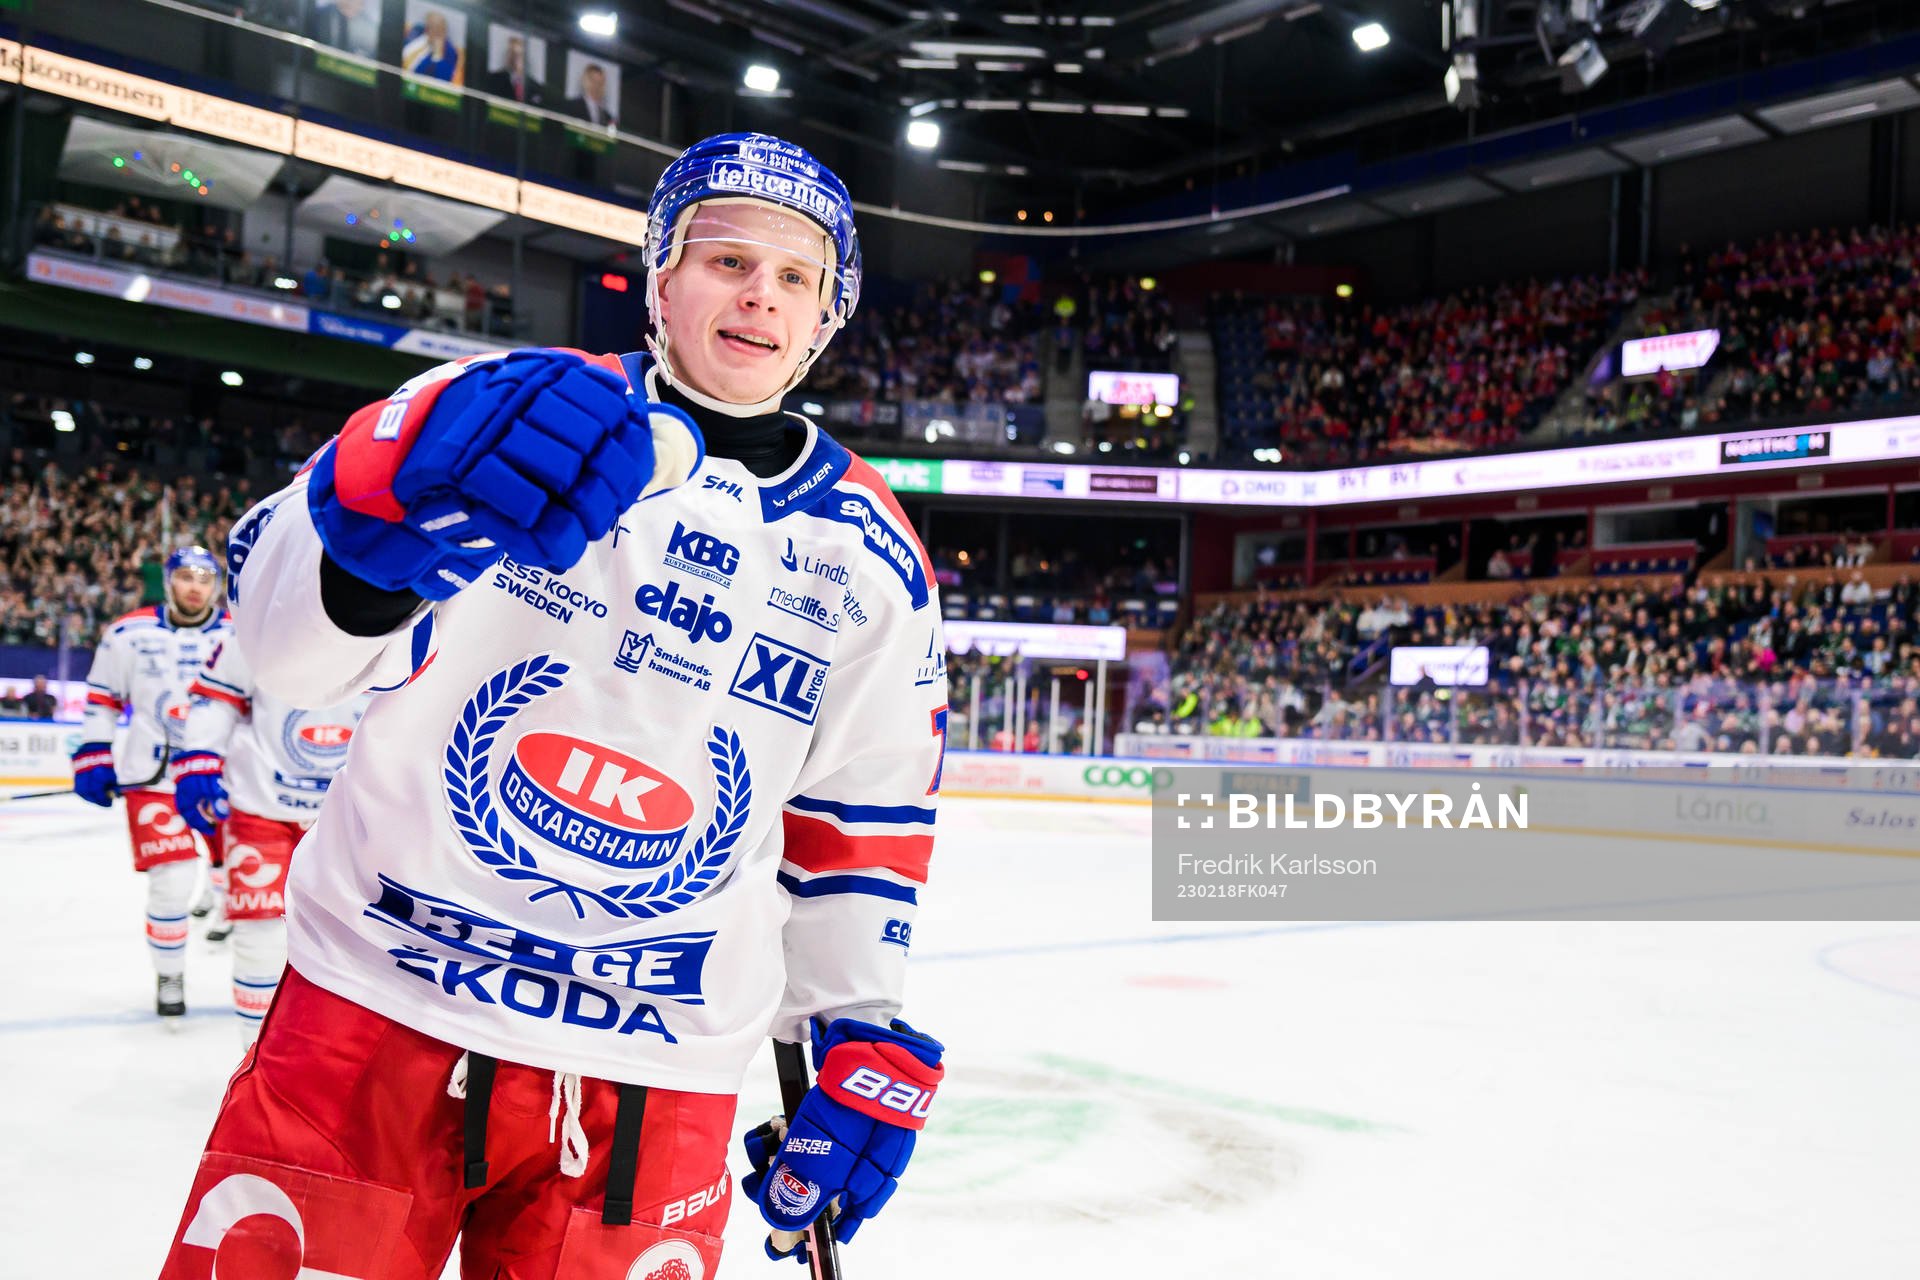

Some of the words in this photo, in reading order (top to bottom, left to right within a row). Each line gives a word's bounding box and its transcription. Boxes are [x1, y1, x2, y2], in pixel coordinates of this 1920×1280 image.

[718, 164, 837, 218] telecenter
[702, 474, 744, 504] SHL
[787, 461, 834, 502] BAUER
[667, 520, 740, 576] KBG
[498, 553, 544, 585] ESS
[543, 577, 608, 619] KOGYO
[701, 570, 724, 584] GROUP
[804, 556, 849, 586] Lindb
[492, 572, 574, 624] SWEDEN
[635, 581, 732, 644] elajo
[770, 586, 841, 627] medlife.s
[648, 659, 693, 685] hamnar
[693, 679, 712, 692] AB
[654, 646, 713, 677] Smålands-
[737, 642, 815, 716] XL
[556, 746, 664, 823] IK
[1083, 765, 1175, 796] coop
[504, 775, 678, 863] OSKARSHAMN
[885, 919, 912, 942] CO
